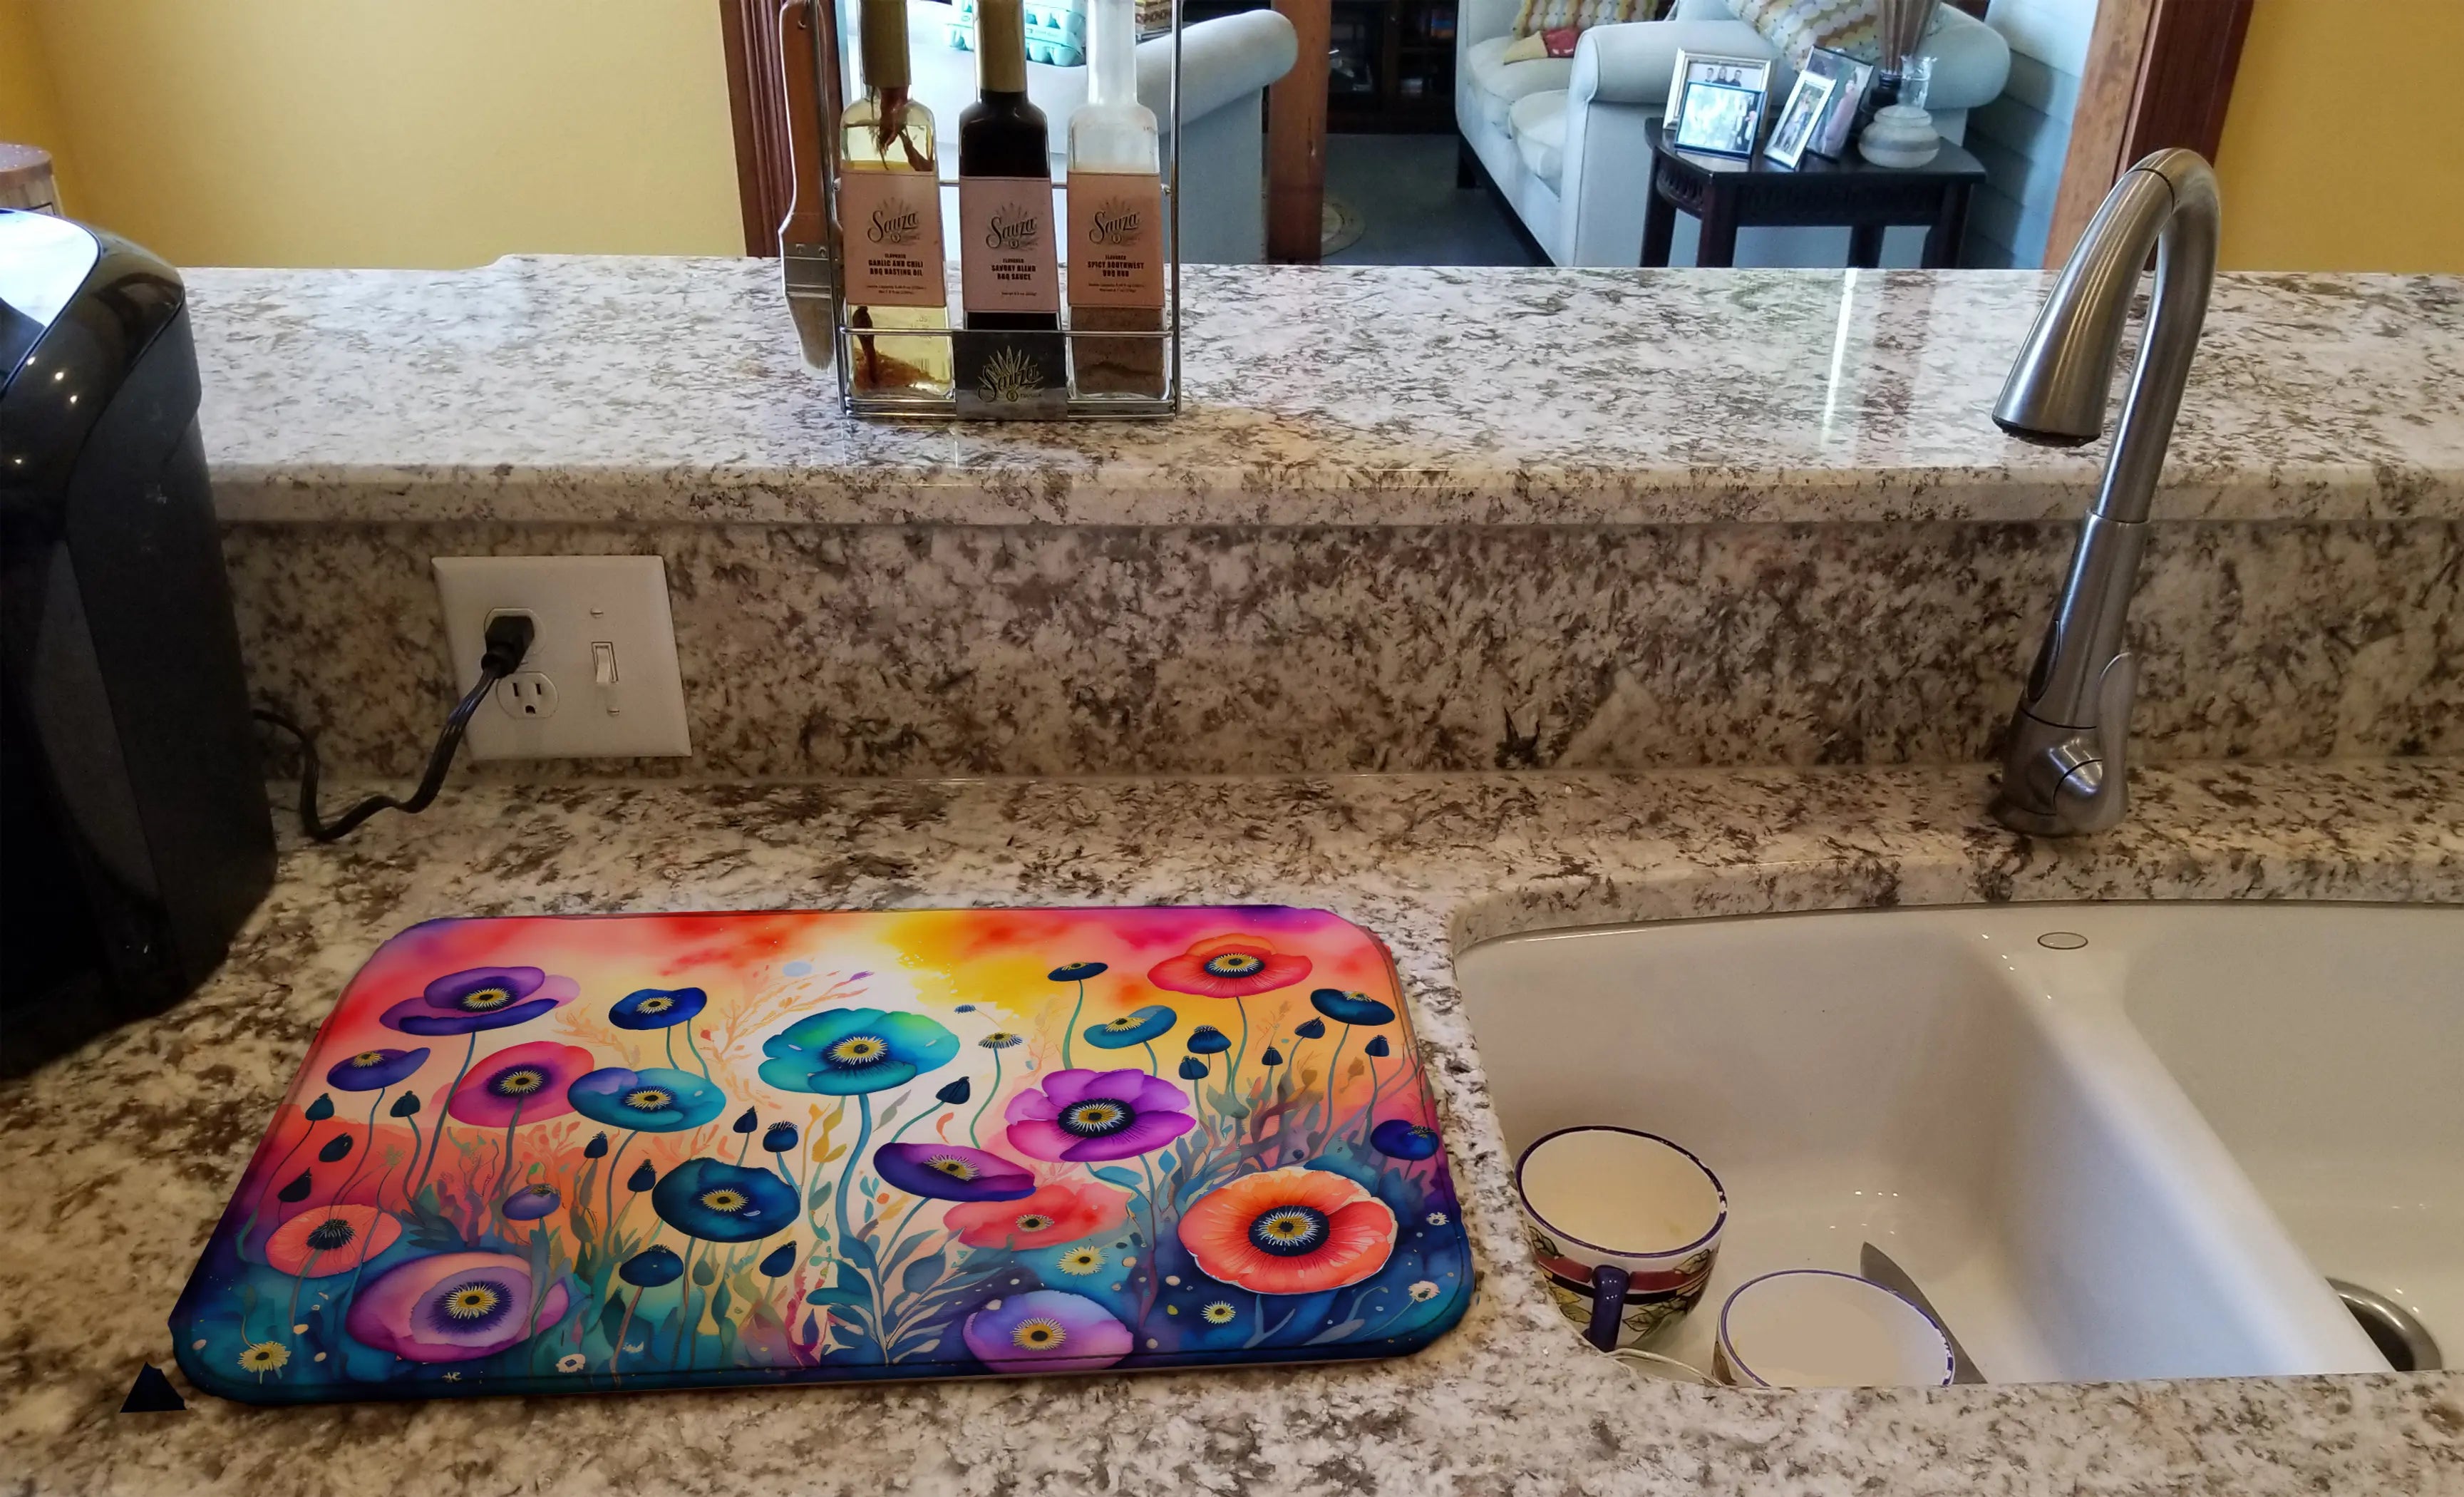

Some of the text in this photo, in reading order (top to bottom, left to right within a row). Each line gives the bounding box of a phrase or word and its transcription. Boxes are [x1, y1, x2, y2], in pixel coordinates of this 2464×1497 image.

[867, 210, 918, 243] Sauza
[986, 216, 1037, 249] Sauza
[1088, 211, 1140, 244] Sauza
[977, 364, 1043, 403] Sauza
